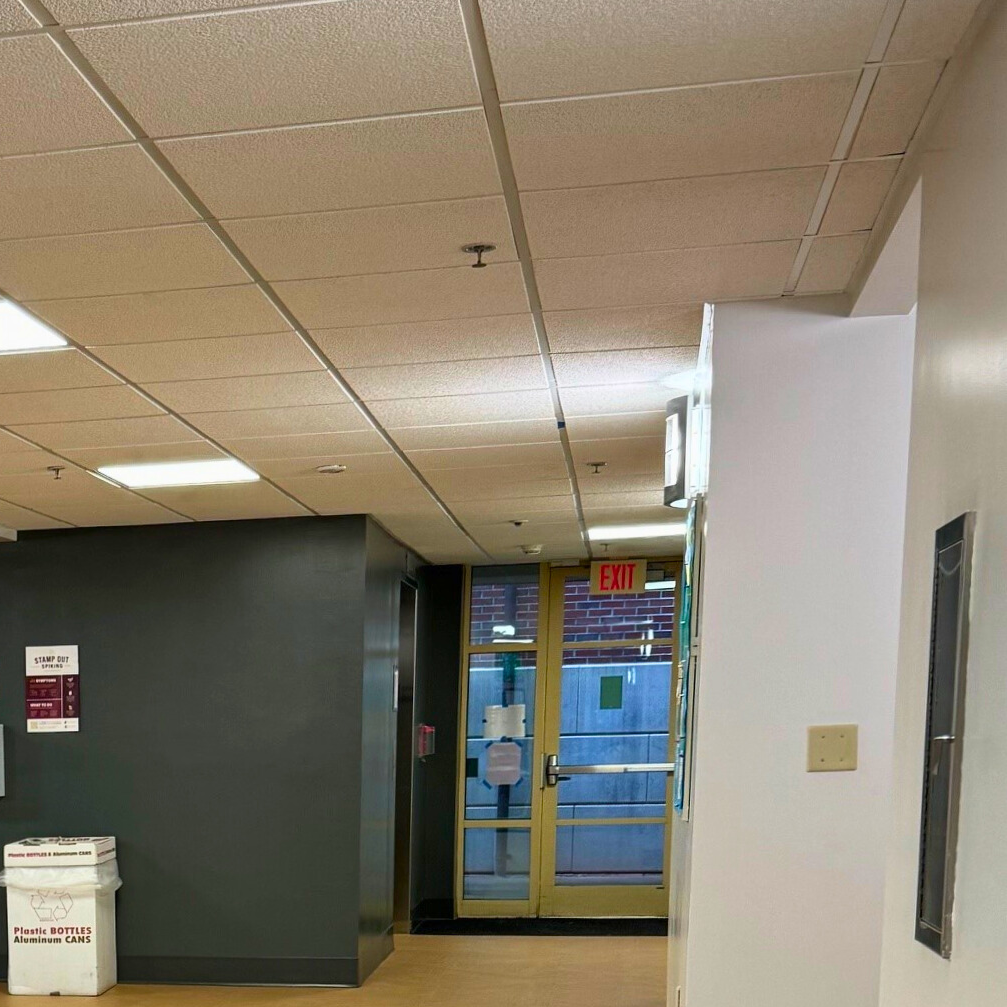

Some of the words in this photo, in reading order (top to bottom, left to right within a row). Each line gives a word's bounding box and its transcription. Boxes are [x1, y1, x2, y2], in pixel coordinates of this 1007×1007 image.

[600, 564, 635, 590] EXIT
[34, 656, 55, 664] STAMP
[14, 927, 47, 935] Plastic
[50, 927, 92, 935] BOTTLES
[14, 936, 61, 944] Aluminum
[65, 936, 91, 944] CANS
